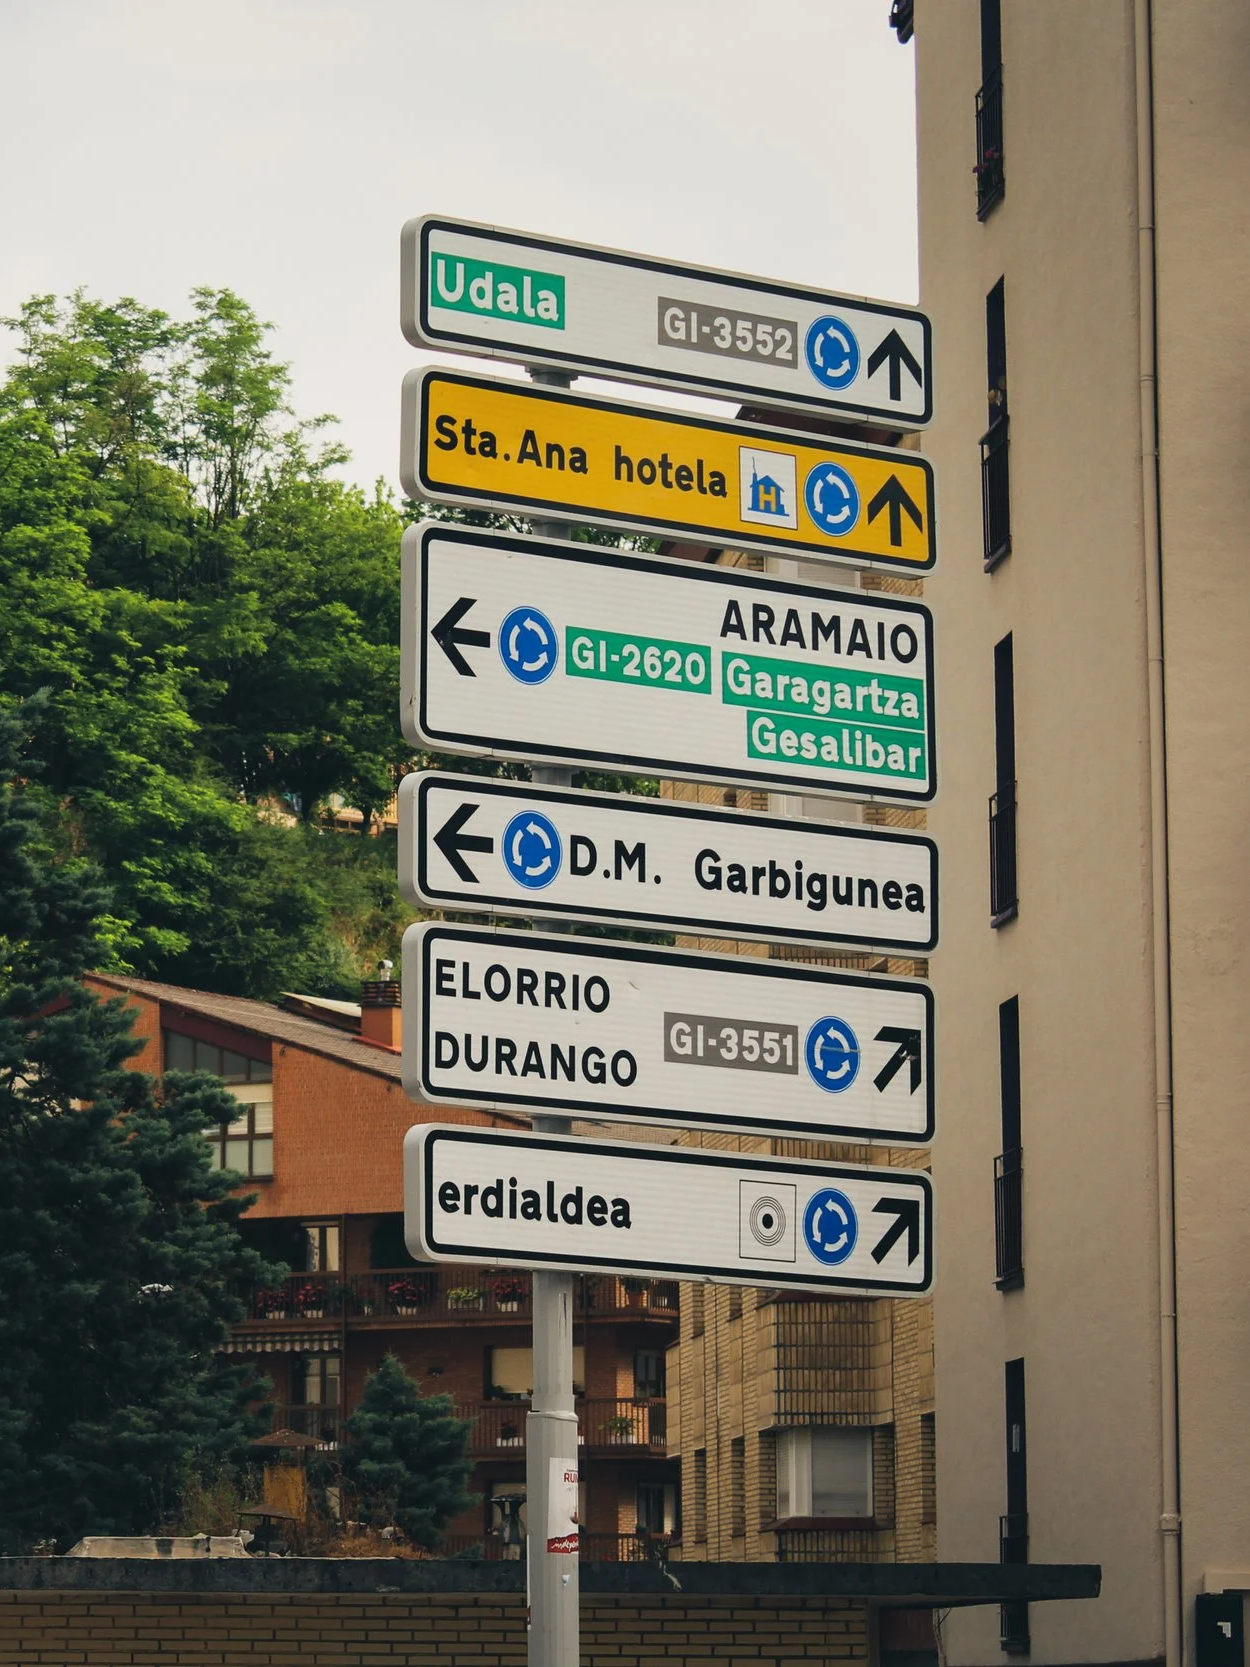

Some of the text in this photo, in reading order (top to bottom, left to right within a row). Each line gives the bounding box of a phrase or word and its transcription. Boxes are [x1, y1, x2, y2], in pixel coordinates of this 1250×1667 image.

[434, 257, 559, 322] Udala
[663, 306, 793, 361] GI-3552
[614, 445, 728, 498] hotela
[719, 599, 918, 663] ARAMAIO
[571, 635, 706, 685] GI-2620
[726, 658, 920, 719] Garagartza
[751, 717, 921, 774] Gesalibar
[569, 834, 926, 914] D.M. Garbigunea
[435, 958, 610, 1014] ELORRIO
[434, 1031, 638, 1088] DURANGO
[668, 1020, 794, 1067] GI-3551
[437, 1176, 632, 1229] erdialdea
